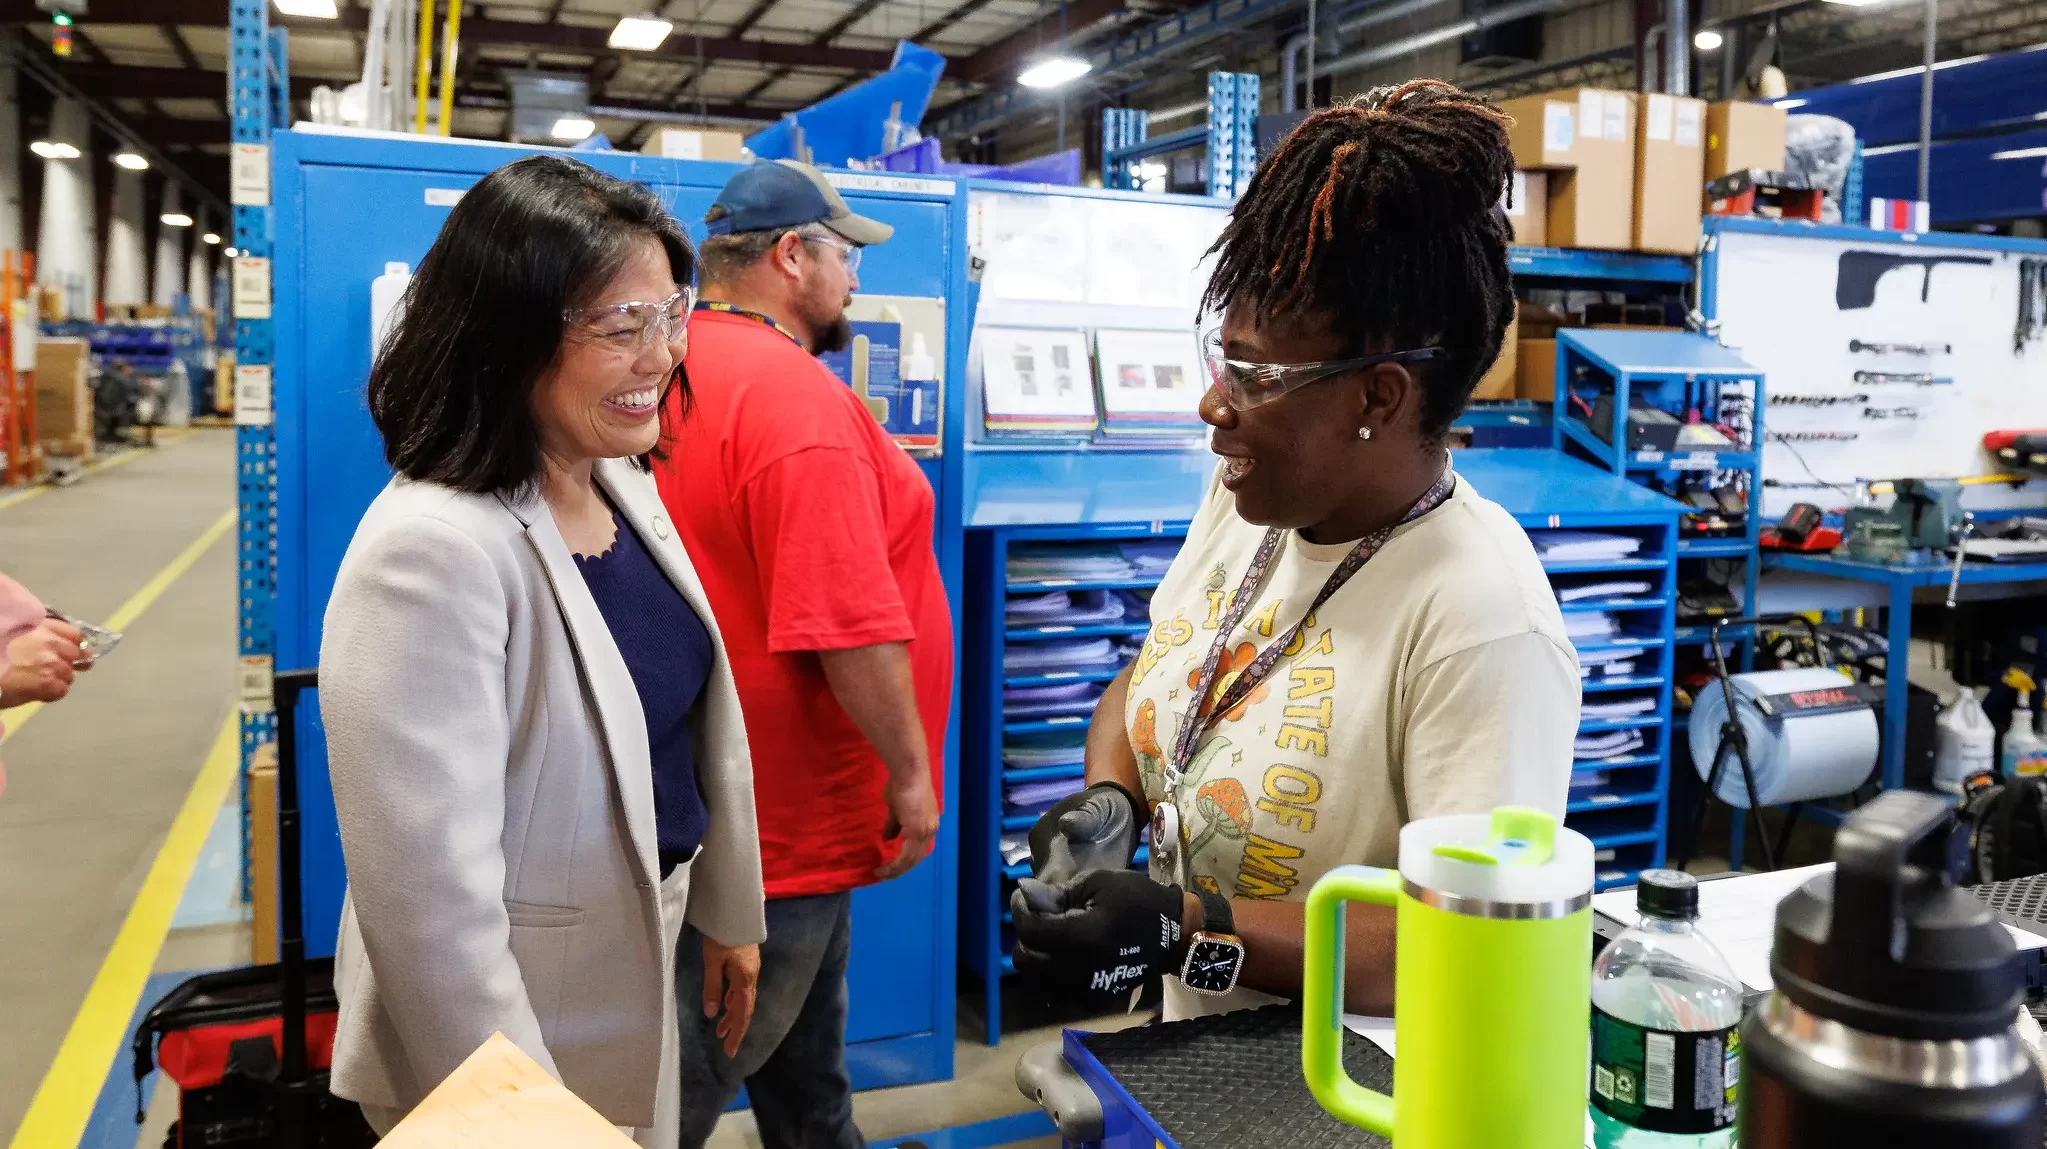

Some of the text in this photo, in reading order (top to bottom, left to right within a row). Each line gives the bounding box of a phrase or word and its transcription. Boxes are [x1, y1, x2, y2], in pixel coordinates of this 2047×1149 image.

[1244, 599, 1282, 637] A
[1127, 608, 1193, 708] NESS
[1255, 763, 1323, 834] OF
[1160, 912, 1169, 948] Ansell
